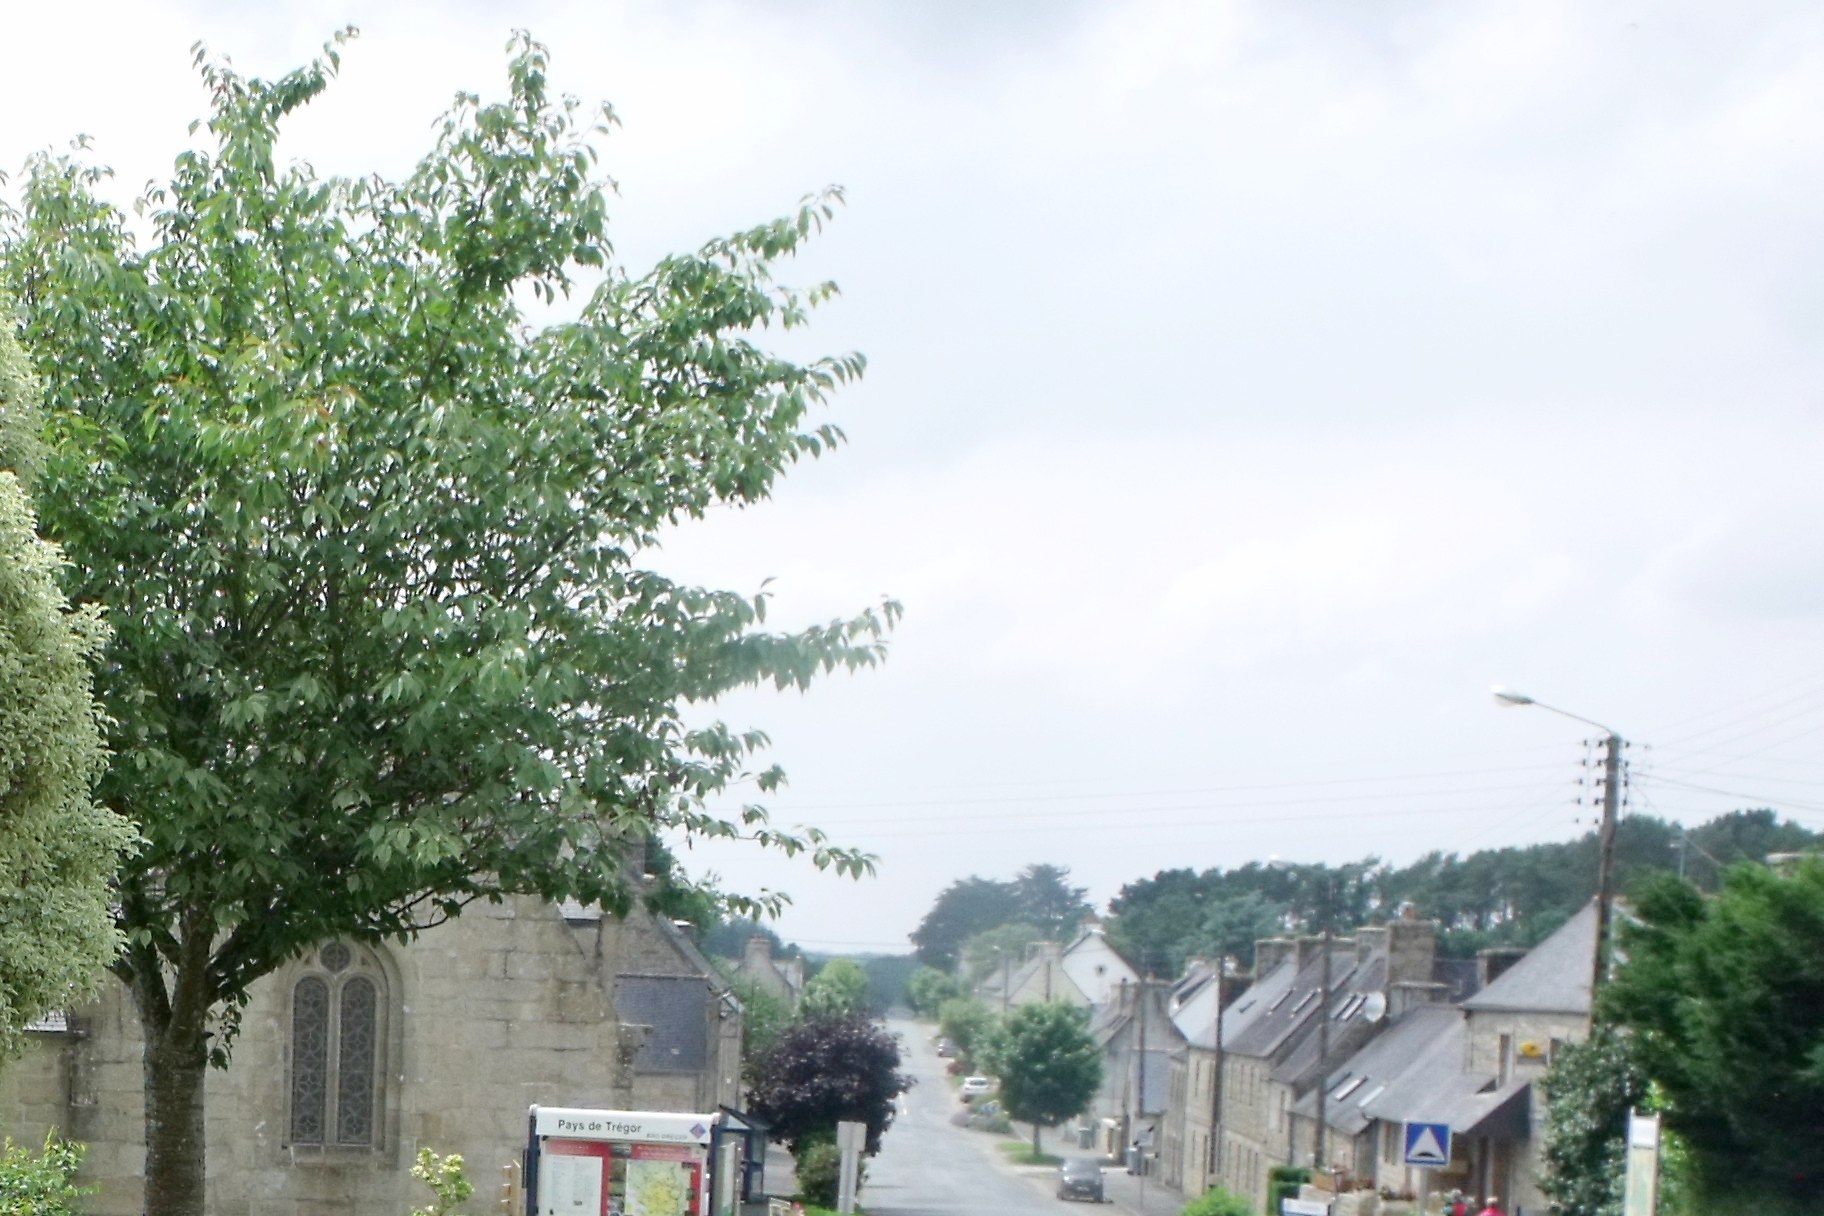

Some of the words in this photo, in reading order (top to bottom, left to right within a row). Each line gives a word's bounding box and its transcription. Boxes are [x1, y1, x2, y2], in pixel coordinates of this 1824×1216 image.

[558, 1119, 585, 1132] Pays
[588, 1121, 602, 1131] de
[606, 1121, 642, 1135] Trégor
